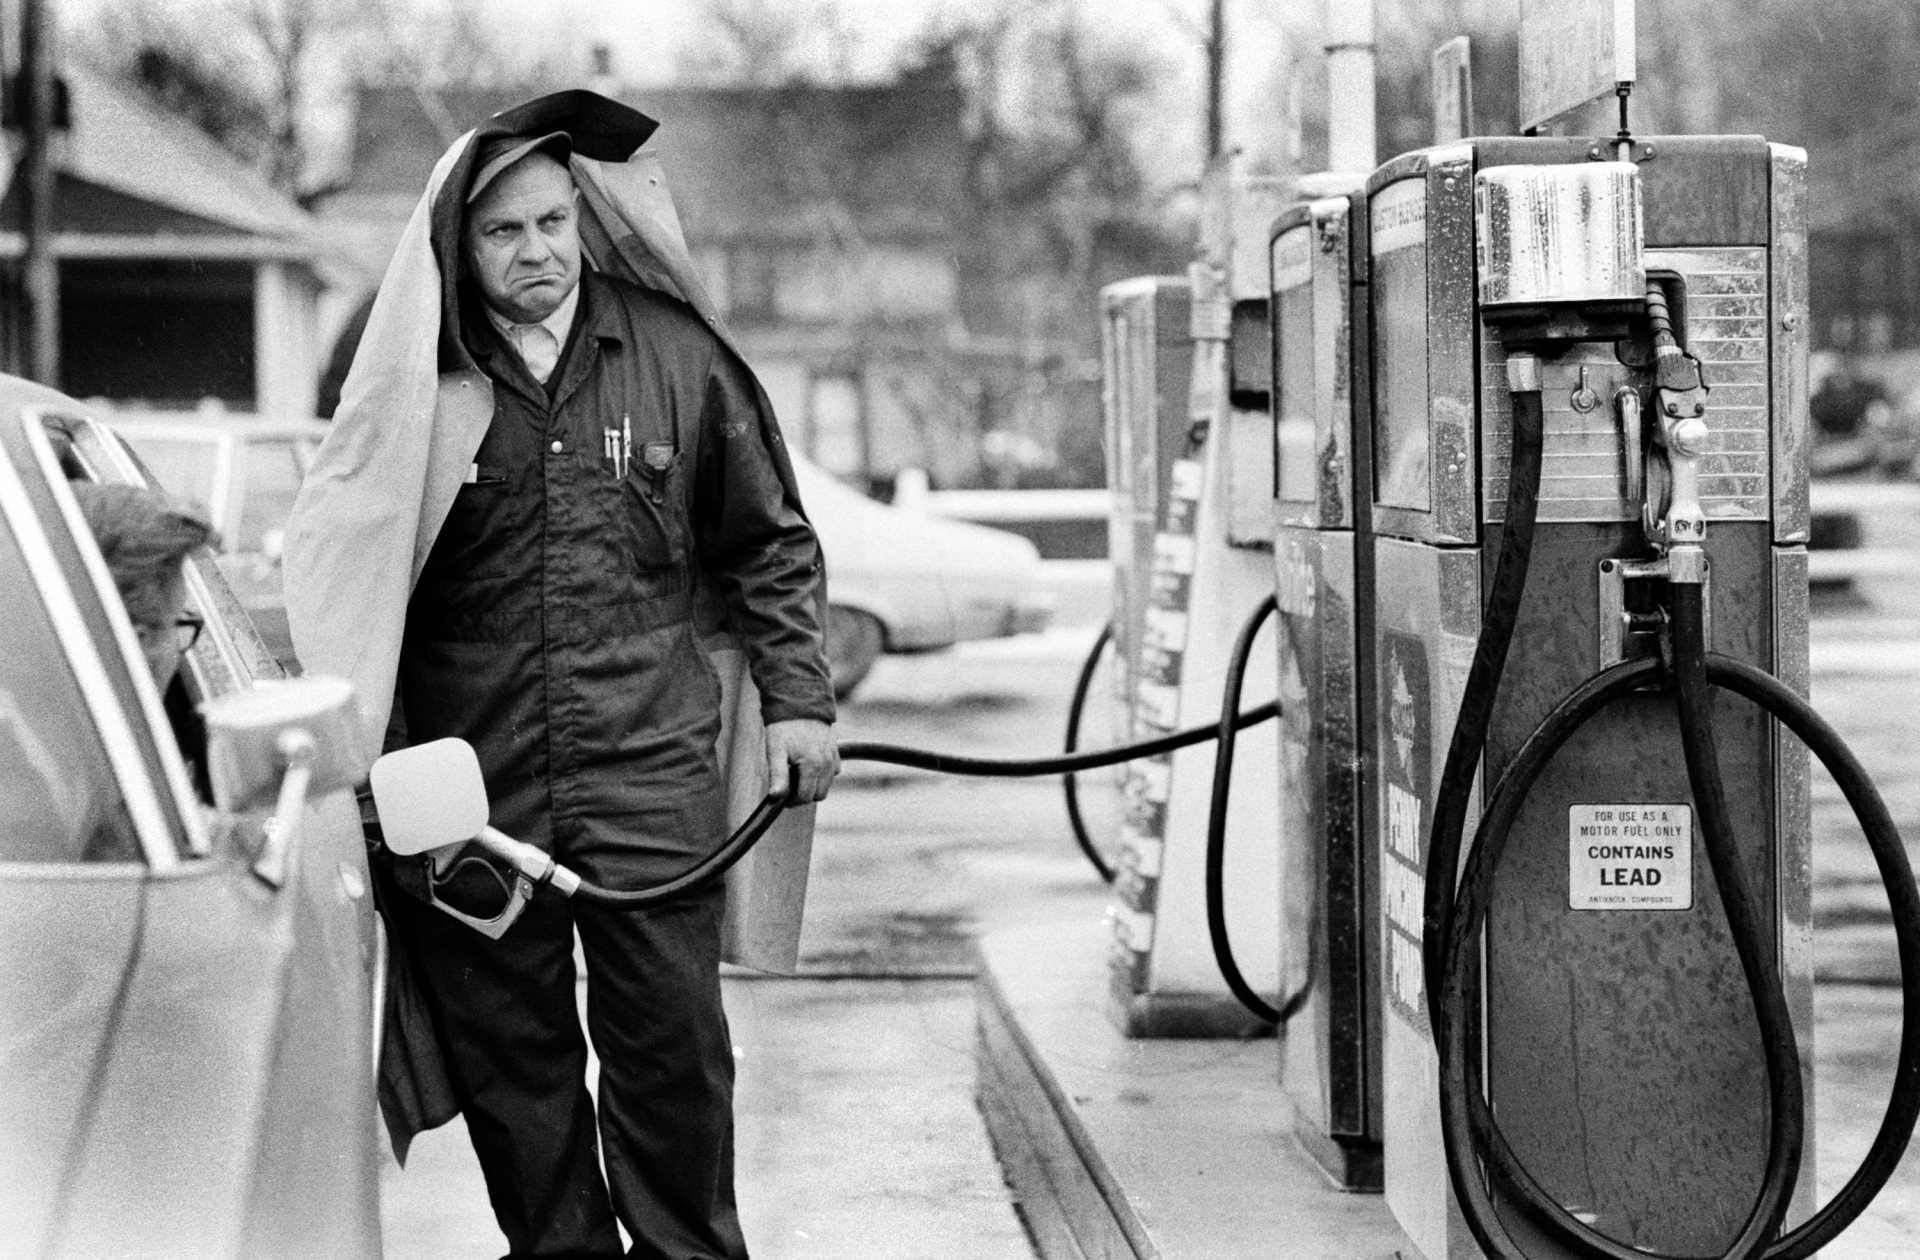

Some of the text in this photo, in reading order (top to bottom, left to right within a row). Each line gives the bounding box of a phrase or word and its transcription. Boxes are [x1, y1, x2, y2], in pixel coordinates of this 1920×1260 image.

[1595, 811, 1668, 822] FOR USE AS A
[1580, 826, 1681, 837] MOTOR FUEL ONLY
[1588, 846, 1674, 859] CONTAINS
[1600, 868, 1661, 886] LEAD
